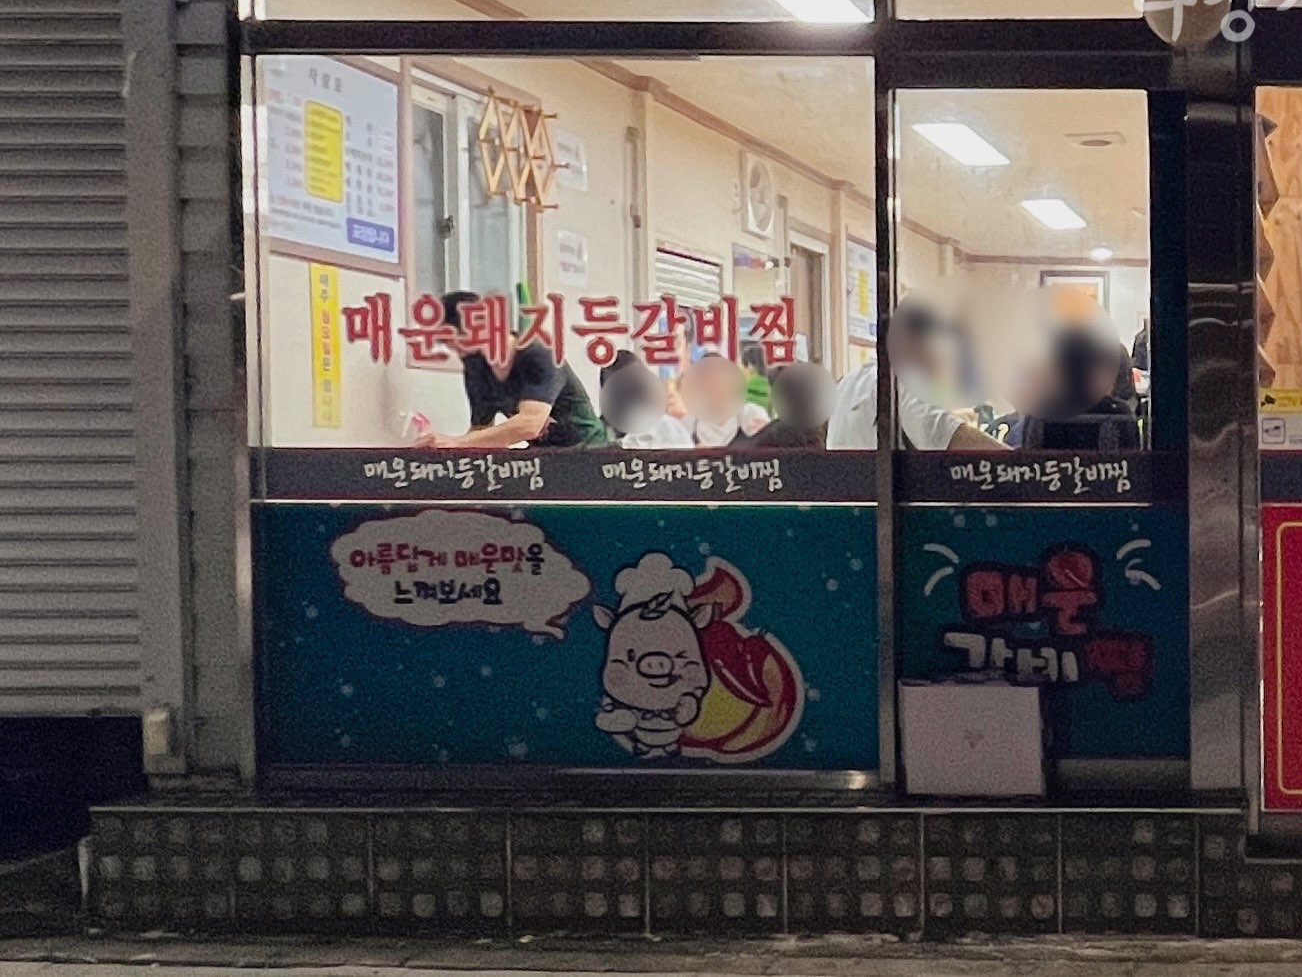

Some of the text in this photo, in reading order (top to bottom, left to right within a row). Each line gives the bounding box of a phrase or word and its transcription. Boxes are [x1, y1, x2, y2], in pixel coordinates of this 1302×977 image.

[342, 293, 798, 367] 매운돼지등갈비찜
[364, 456, 544, 491] 매운돼지등갈비찜
[602, 456, 783, 492] 매운돼지등갈비찜
[951, 457, 1131, 494] 매운돼지등갈비찜
[350, 542, 545, 575] 아름답게 매운맛을
[394, 577, 503, 605] 느껴보세요
